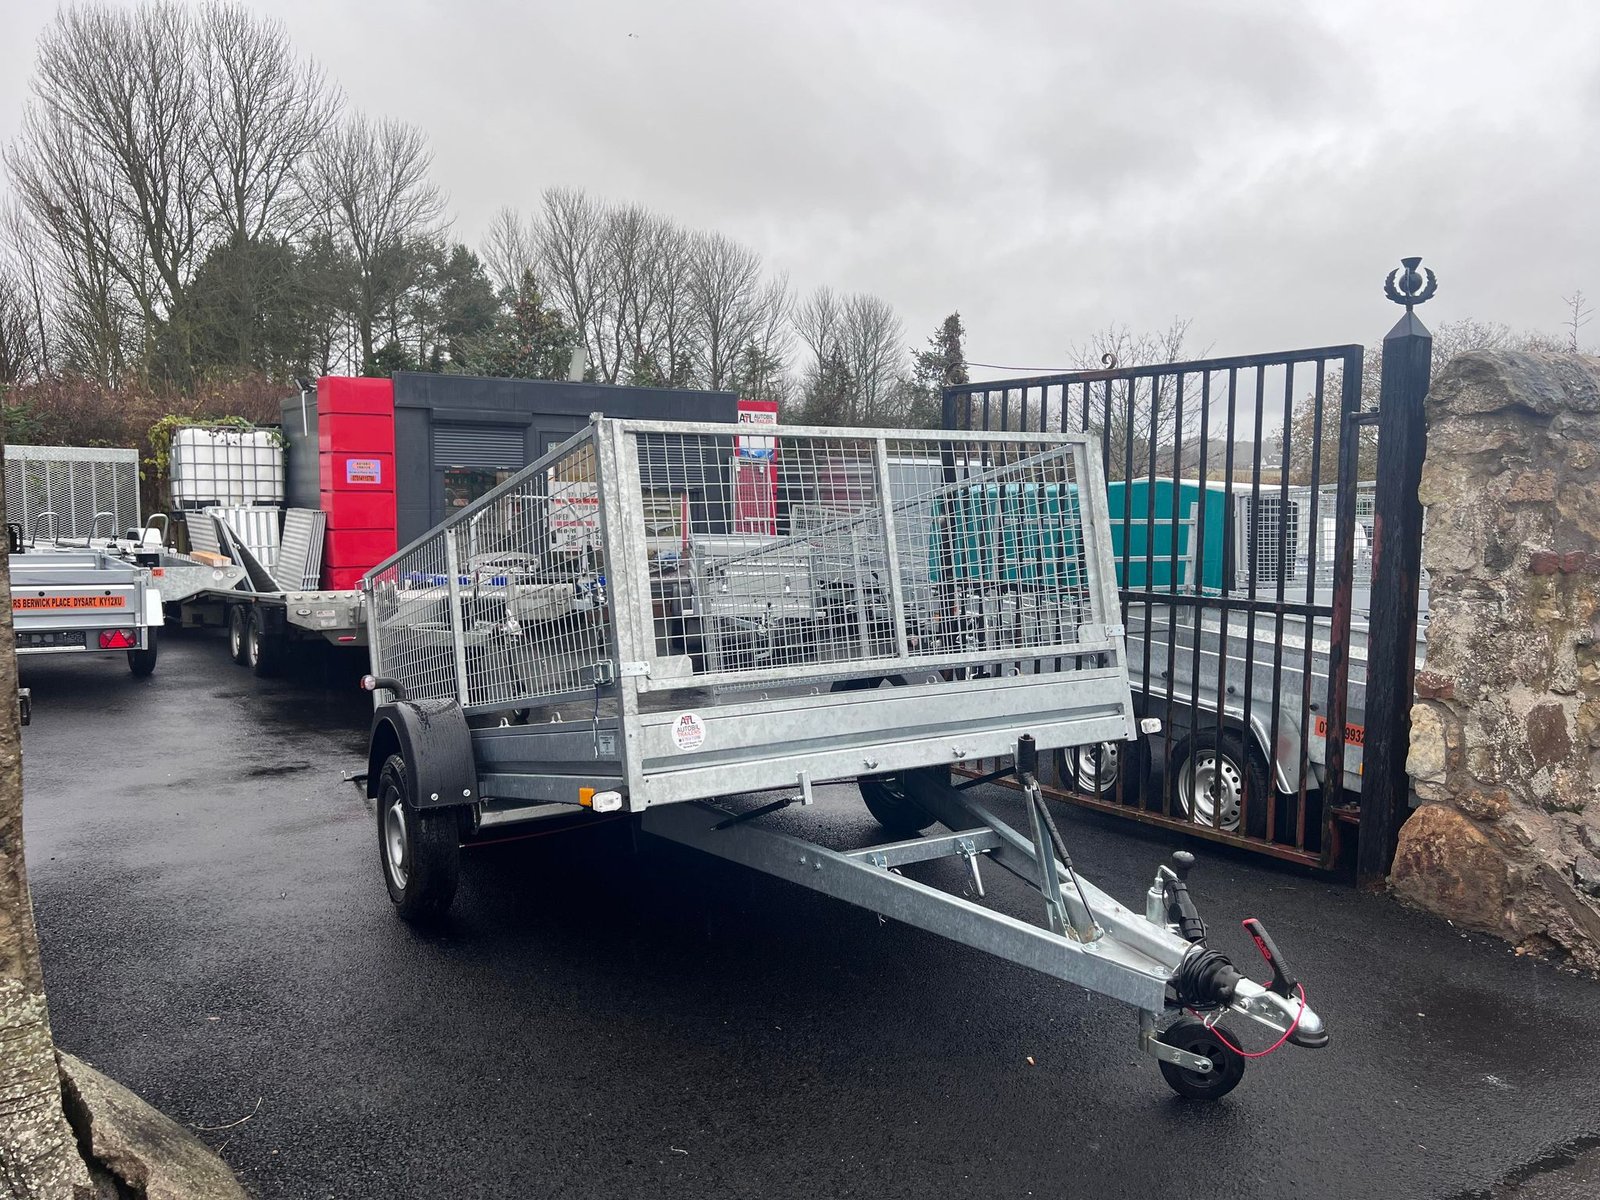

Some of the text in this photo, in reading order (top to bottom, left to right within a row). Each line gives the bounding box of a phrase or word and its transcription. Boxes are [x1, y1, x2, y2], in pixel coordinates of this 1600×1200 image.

[739, 413, 754, 423] ATL
[22, 598, 51, 608] BERWICK
[681, 715, 696, 725] ATL
